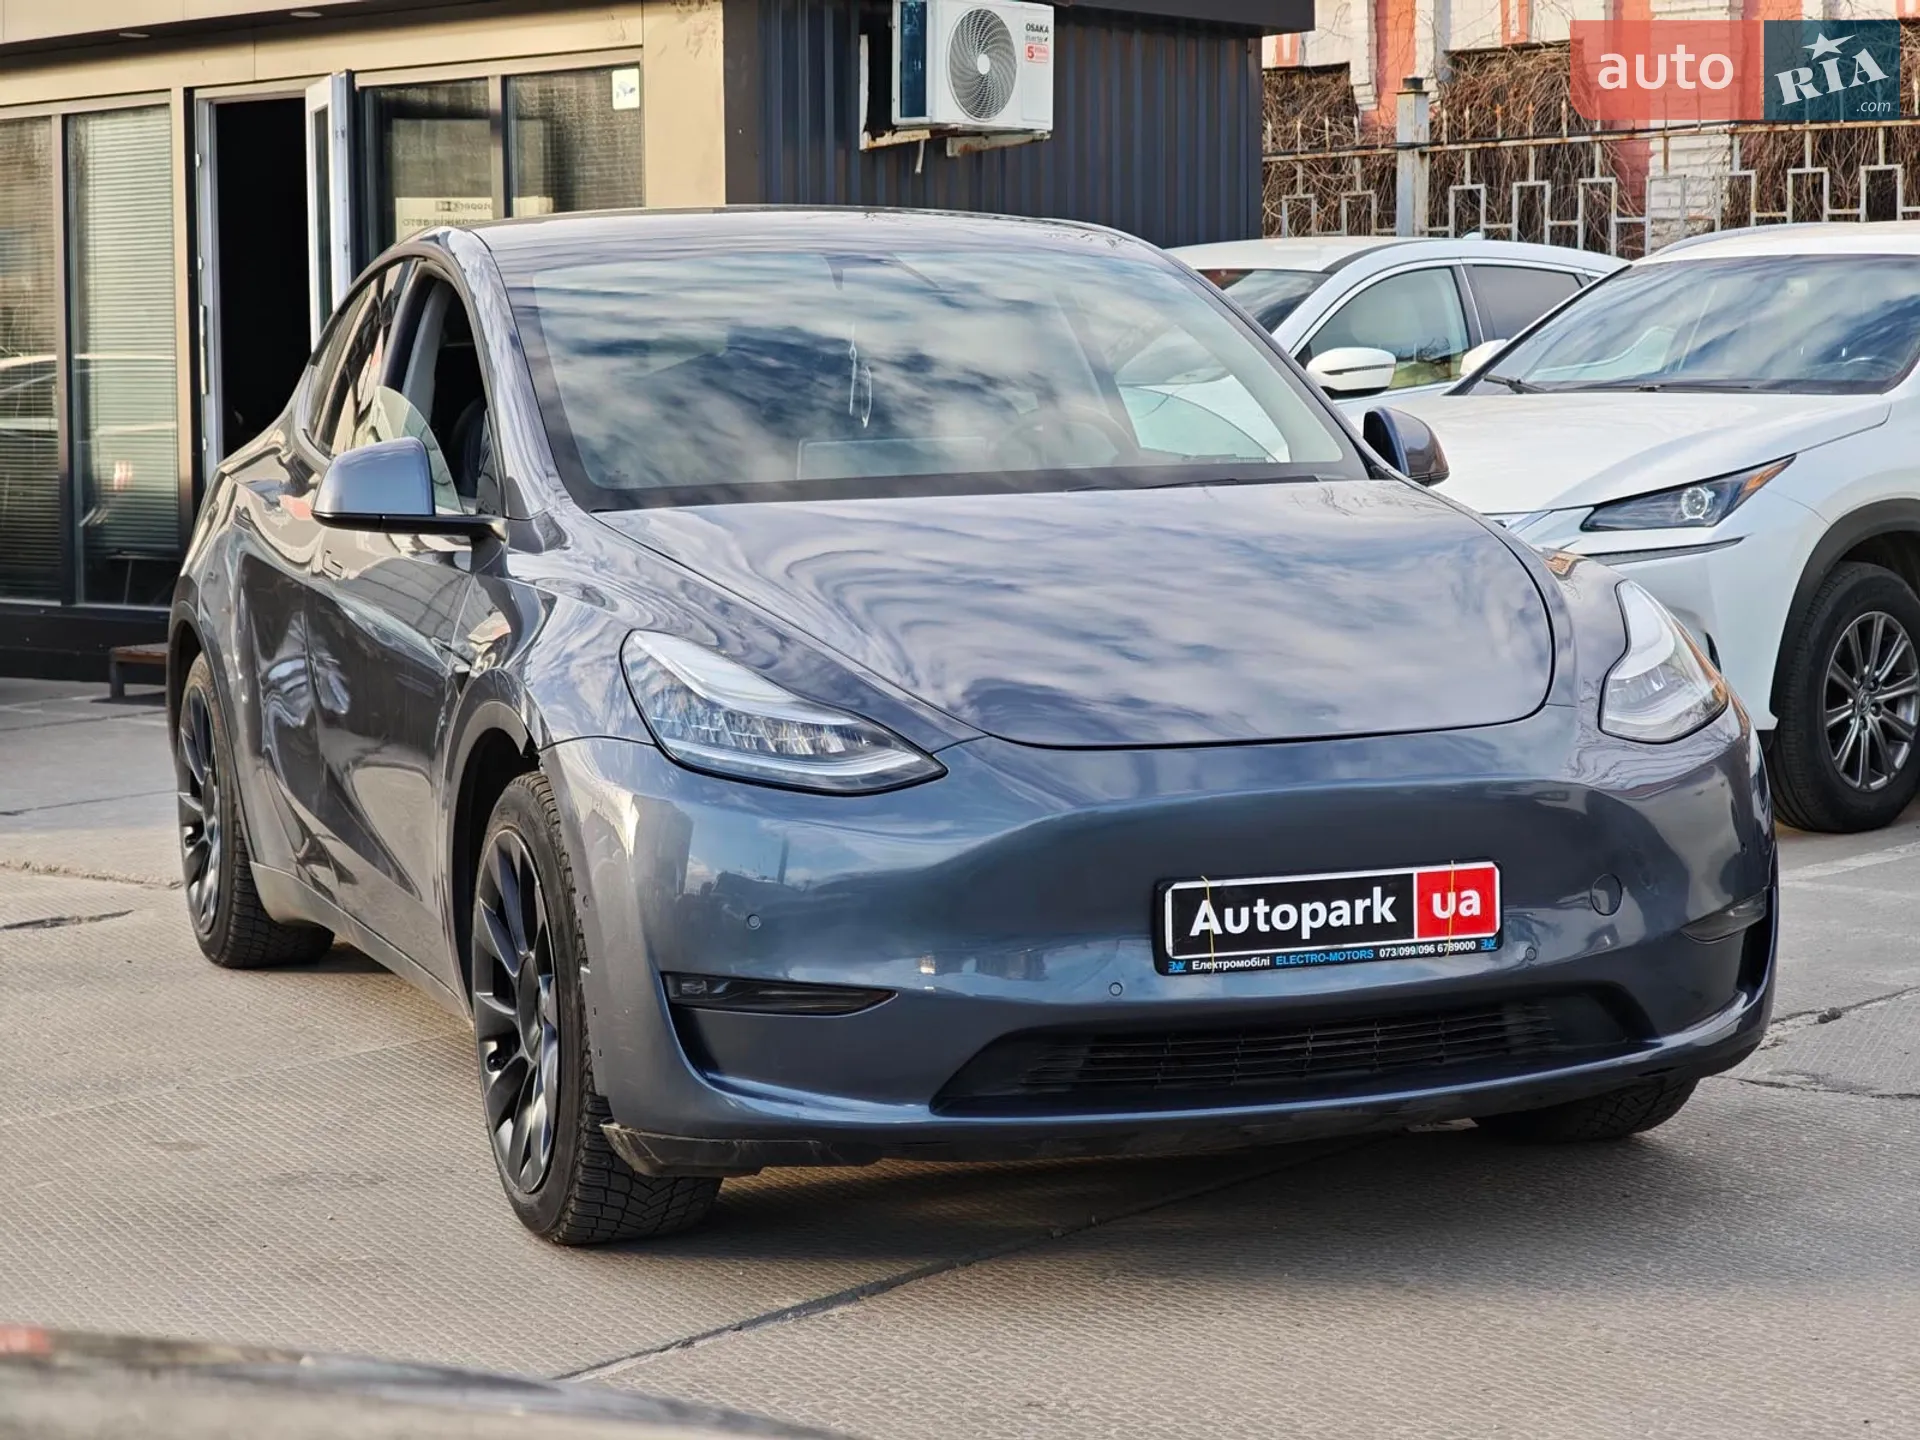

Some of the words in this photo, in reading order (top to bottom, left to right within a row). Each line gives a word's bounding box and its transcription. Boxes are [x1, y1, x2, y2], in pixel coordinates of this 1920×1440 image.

[1025, 23, 1049, 33] OSAKA
[1027, 46, 1034, 58] 5
[1189, 886, 1397, 940] Autopark
[1432, 889, 1480, 919] ua
[1275, 949, 1374, 966] ELECTRO-MOTORS
[1437, 940, 1476, 953] 6789000
[1192, 957, 1271, 971] Електромобілі
